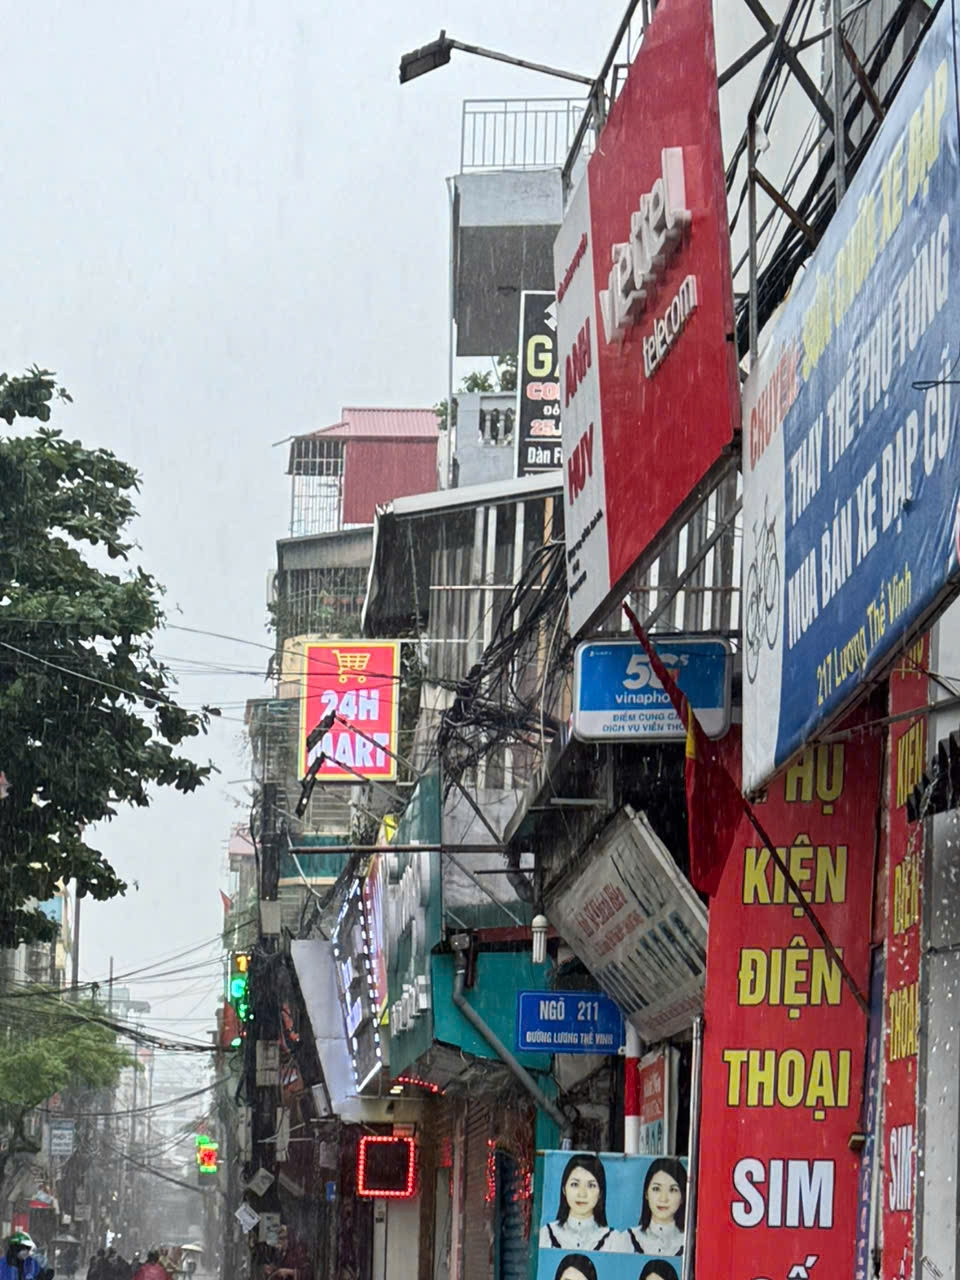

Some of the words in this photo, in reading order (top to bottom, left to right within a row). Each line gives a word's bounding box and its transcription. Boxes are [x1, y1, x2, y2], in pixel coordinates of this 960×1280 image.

[642, 274, 698, 378] telecom
[790, 413, 824, 526] THAY
[827, 352, 855, 472] THẾ
[858, 315, 892, 410] PHỤ
[898, 213, 950, 366] TÙNG
[528, 446, 551, 464] Dàn
[567, 421, 594, 507] HUY
[788, 547, 819, 650] MUA
[856, 462, 877, 567] XE
[881, 410, 918, 533] ĐẠP
[817, 653, 833, 706] 217
[834, 624, 868, 689] Lương
[867, 583, 886, 642] Thế
[887, 561, 912, 625] Vinh
[320, 688, 380, 721] 24H
[615, 690, 671, 706] vinapho
[639, 712, 665, 722] CUNG
[306, 732, 390, 768] MART
[751, 743, 845, 815] HỤ
[743, 833, 848, 918] KIỆN
[539, 997, 566, 1021] NGÕ
[577, 1000, 599, 1021] 211
[738, 935, 843, 1020] ĐIỆN
[526, 1028, 552, 1044] ĐƯỜNG
[723, 1048, 852, 1120] THOẠI
[730, 1157, 835, 1230] SIM
[889, 1123, 913, 1212] SIM
